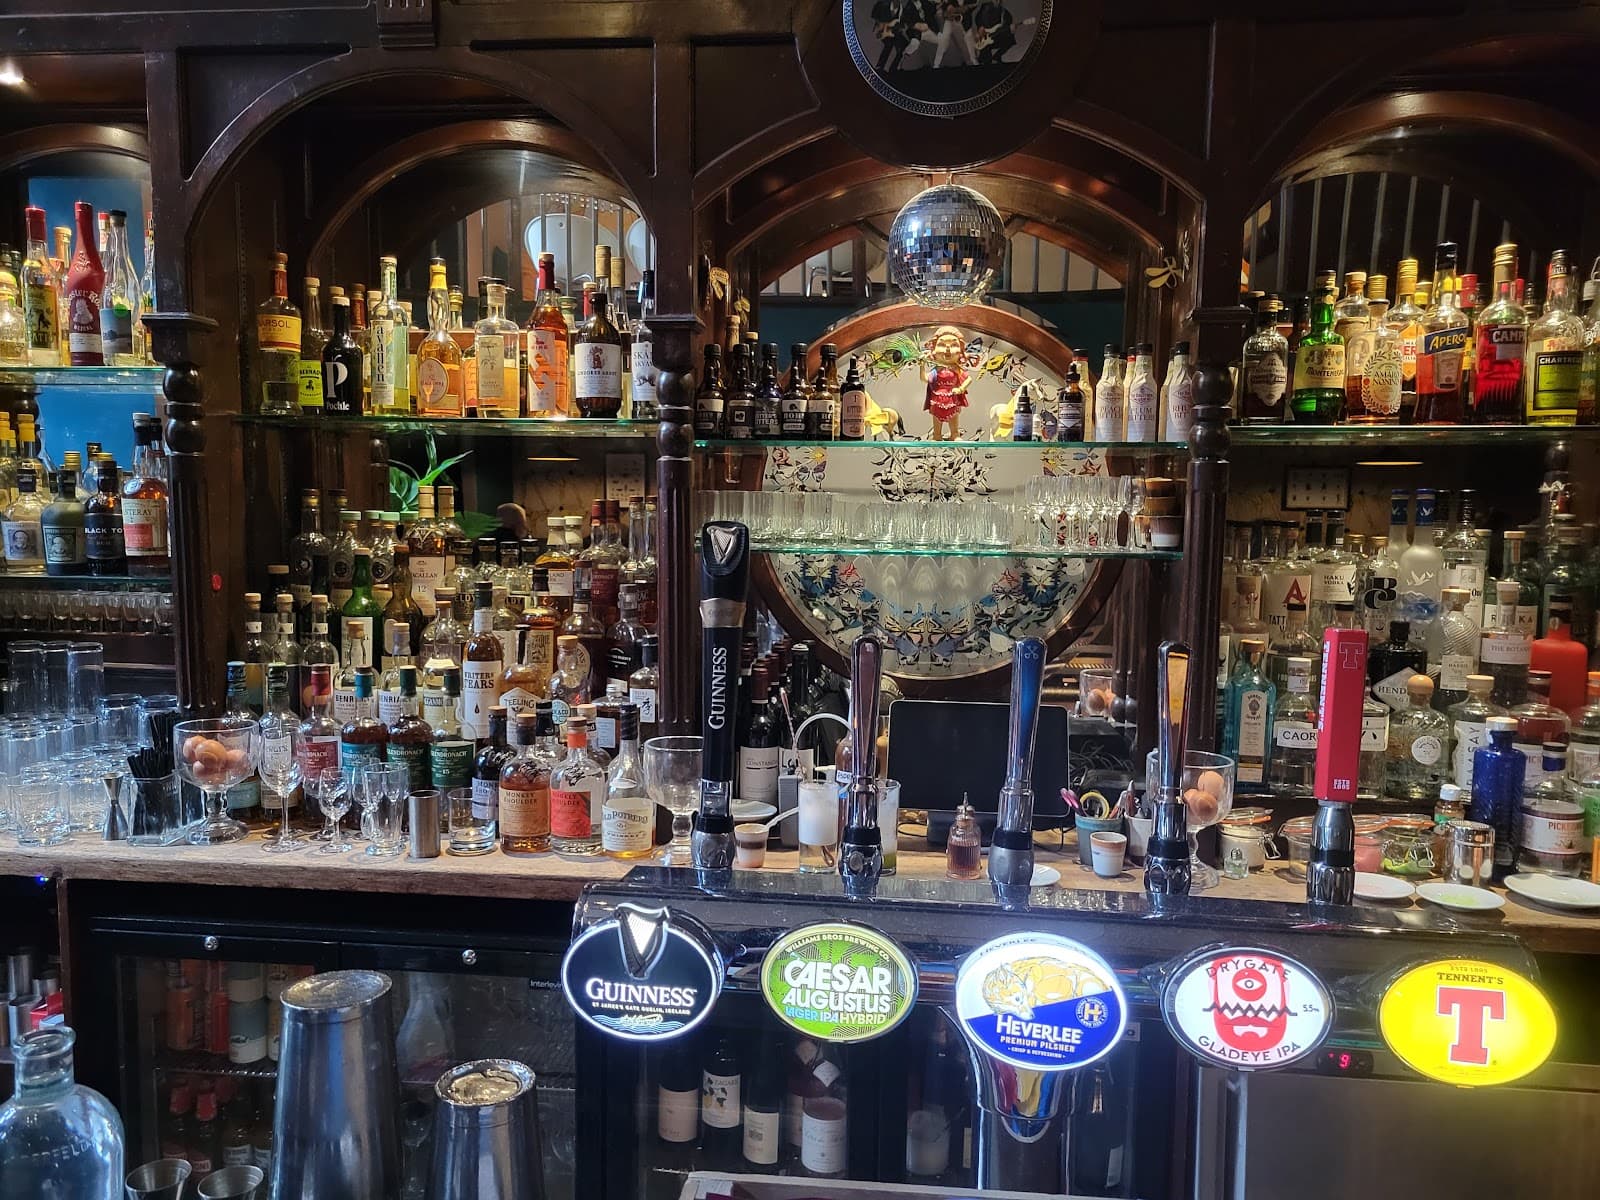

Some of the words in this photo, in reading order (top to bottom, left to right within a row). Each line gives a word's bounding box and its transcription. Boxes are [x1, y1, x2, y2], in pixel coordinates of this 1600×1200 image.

[260, 319, 292, 329] ARSOL
[1492, 330, 1526, 343] CAMP
[464, 679, 495, 689] TEARS
[707, 646, 728, 730] GUINNESS
[1378, 686, 1408, 695] HEND
[503, 698, 535, 709] TEELING
[1282, 730, 1317, 742] CAOR
[785, 935, 821, 953] WILLIAMS
[844, 936, 879, 954] BREWING
[784, 957, 892, 995] CAESAR
[1205, 959, 1292, 980] DRYGATE
[1436, 972, 1504, 985] TENNENT'S
[585, 977, 698, 1008] GUINNESS
[782, 987, 891, 1013] AUGUSTUS
[839, 1012, 887, 1025] HYBRID
[1437, 985, 1506, 1067] T
[996, 1014, 1082, 1045] HEVERLEE
[1000, 1035, 1038, 1047] PREMIUM
[1039, 1041, 1076, 1053] PILSNER
[1198, 1035, 1272, 1062] GLADEYE
[1277, 1041, 1302, 1058] IPA
